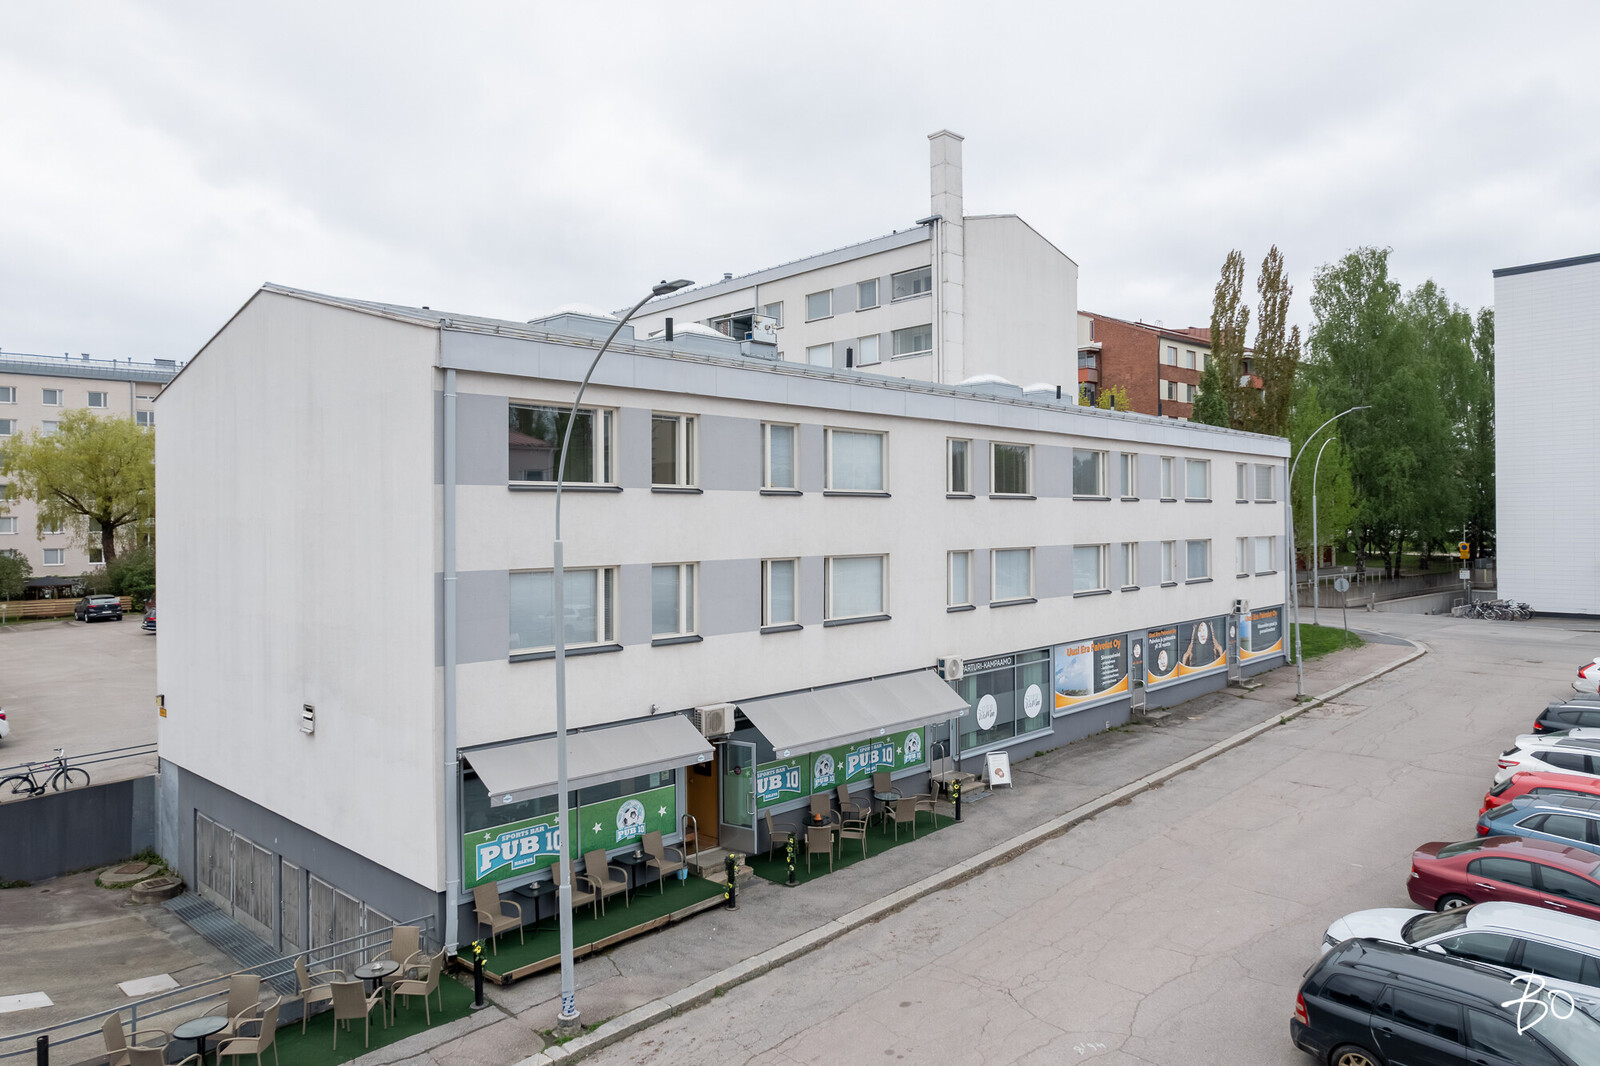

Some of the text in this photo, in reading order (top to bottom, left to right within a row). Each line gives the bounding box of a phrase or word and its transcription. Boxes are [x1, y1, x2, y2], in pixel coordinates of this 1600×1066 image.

[1066, 639, 1121, 656] Uusi Era Palvelut Oy
[963, 657, 1012, 672] ARTURI-KAMPAAMO
[848, 747, 892, 774] PUB 10
[757, 771, 798, 794] UB 10
[816, 776, 829, 786] PUB
[502, 826, 545, 841] SPORTS BAR
[618, 827, 636, 839] PUB
[638, 825, 644, 833] 10
[480, 835, 540, 873] PUB
